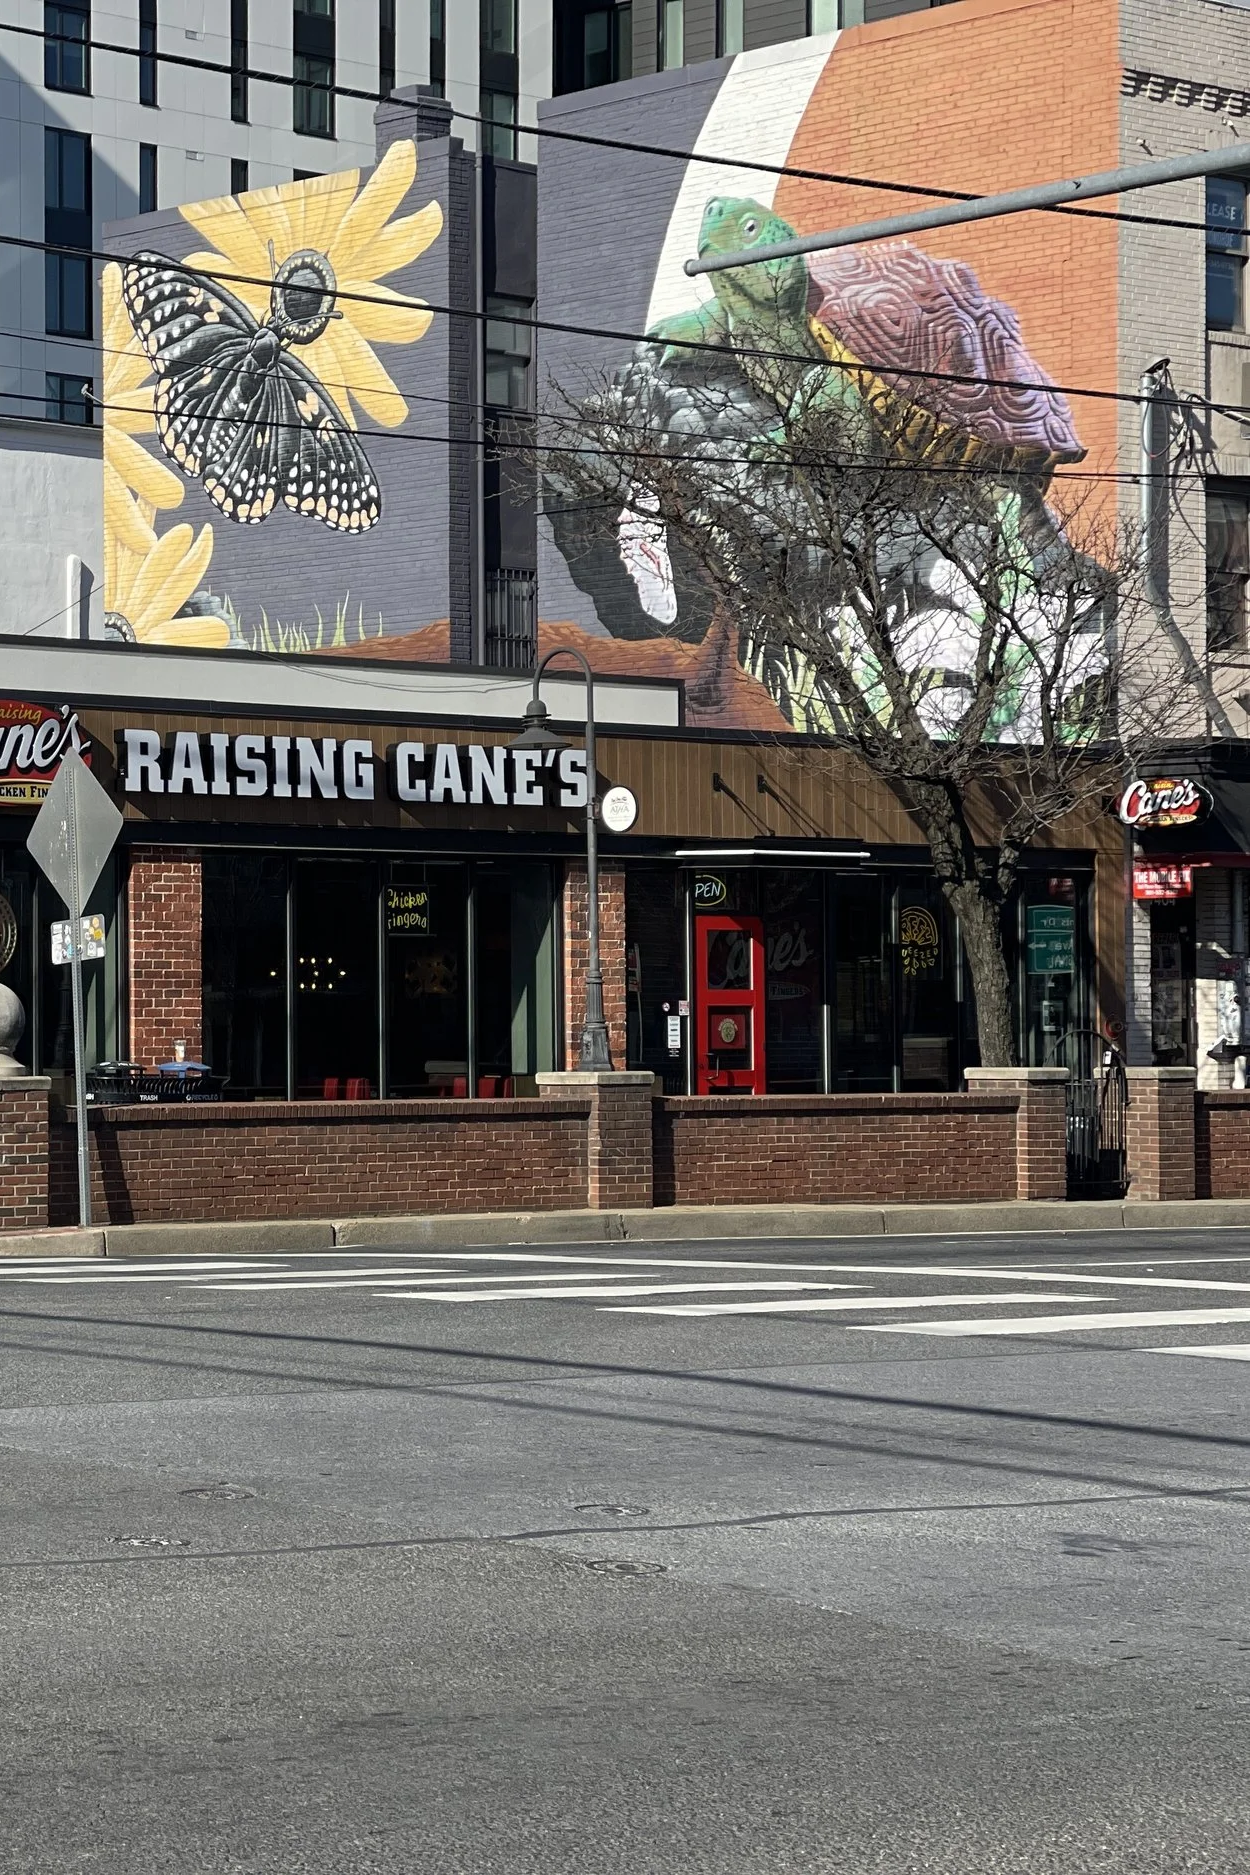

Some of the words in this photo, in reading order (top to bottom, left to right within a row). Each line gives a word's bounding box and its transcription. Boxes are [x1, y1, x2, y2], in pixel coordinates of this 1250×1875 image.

[123, 728, 375, 800] RAISING
[396, 741, 589, 808] CANE'S
[1119, 778, 1200, 825] Cane's
[1133, 871, 1148, 883] THE
[695, 882, 721, 898] PEN
[901, 946, 939, 959] UEEZED
